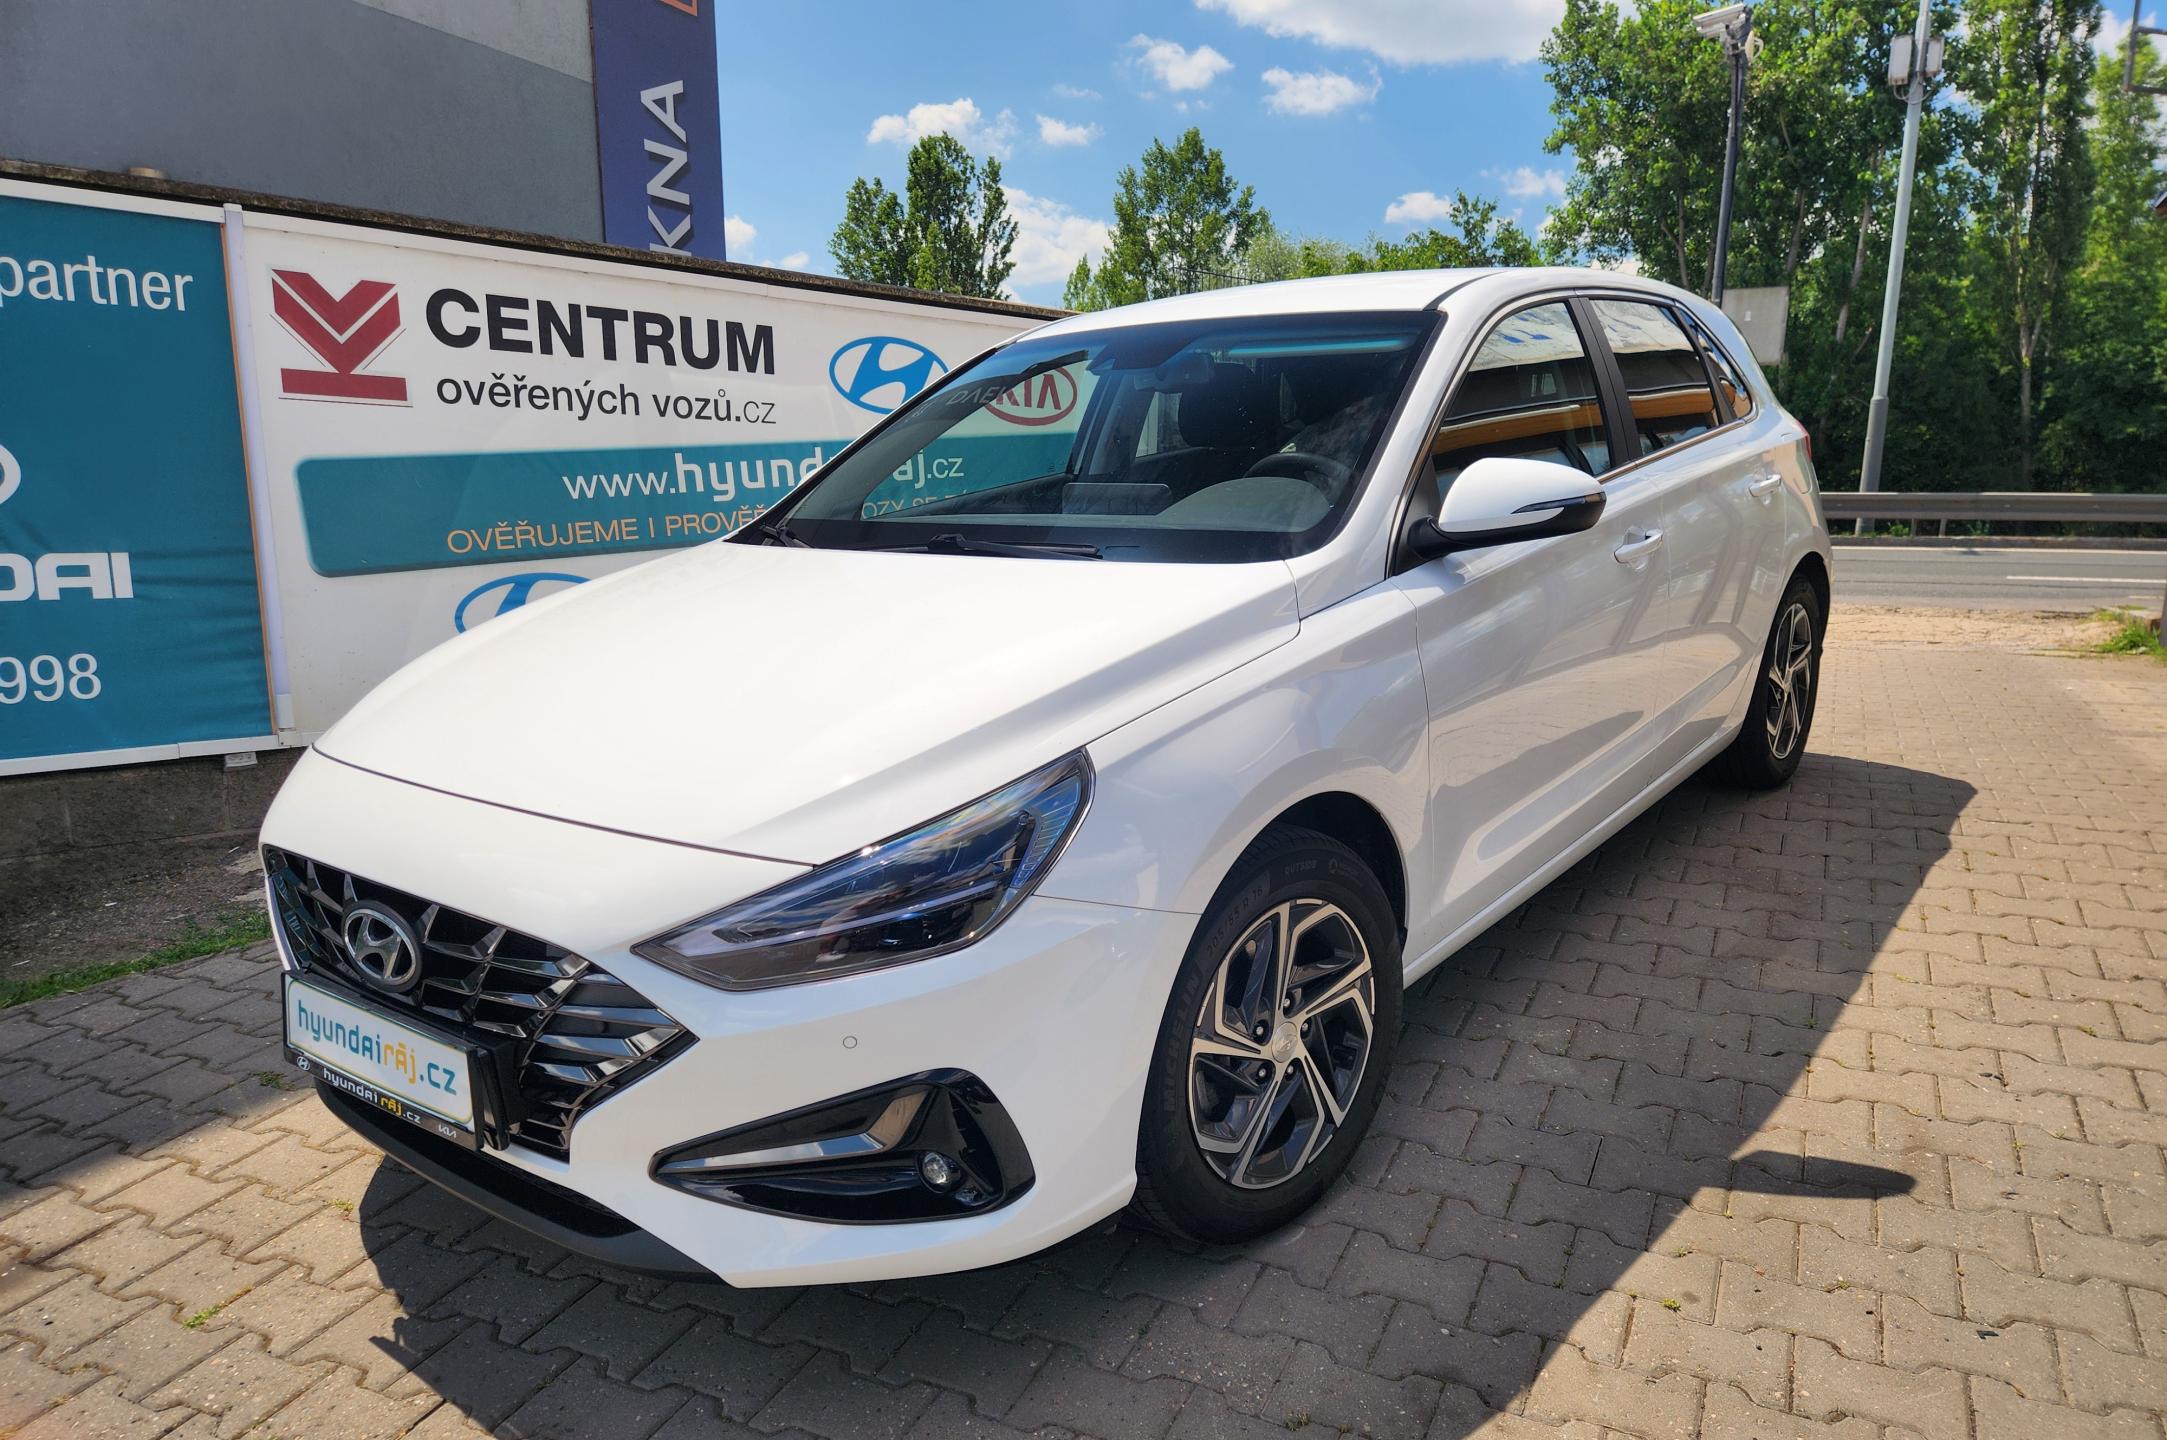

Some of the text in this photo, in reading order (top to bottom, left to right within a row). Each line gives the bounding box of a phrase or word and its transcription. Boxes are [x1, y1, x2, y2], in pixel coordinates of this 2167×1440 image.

[0, 255, 194, 312] partner
[425, 288, 775, 375] CENTRUM
[436, 372, 777, 425] ověřených vozů.cz
[447, 518, 640, 554] OVĚŘUJEME
[665, 504, 766, 537] PROVĚ
[0, 653, 102, 705] 998
